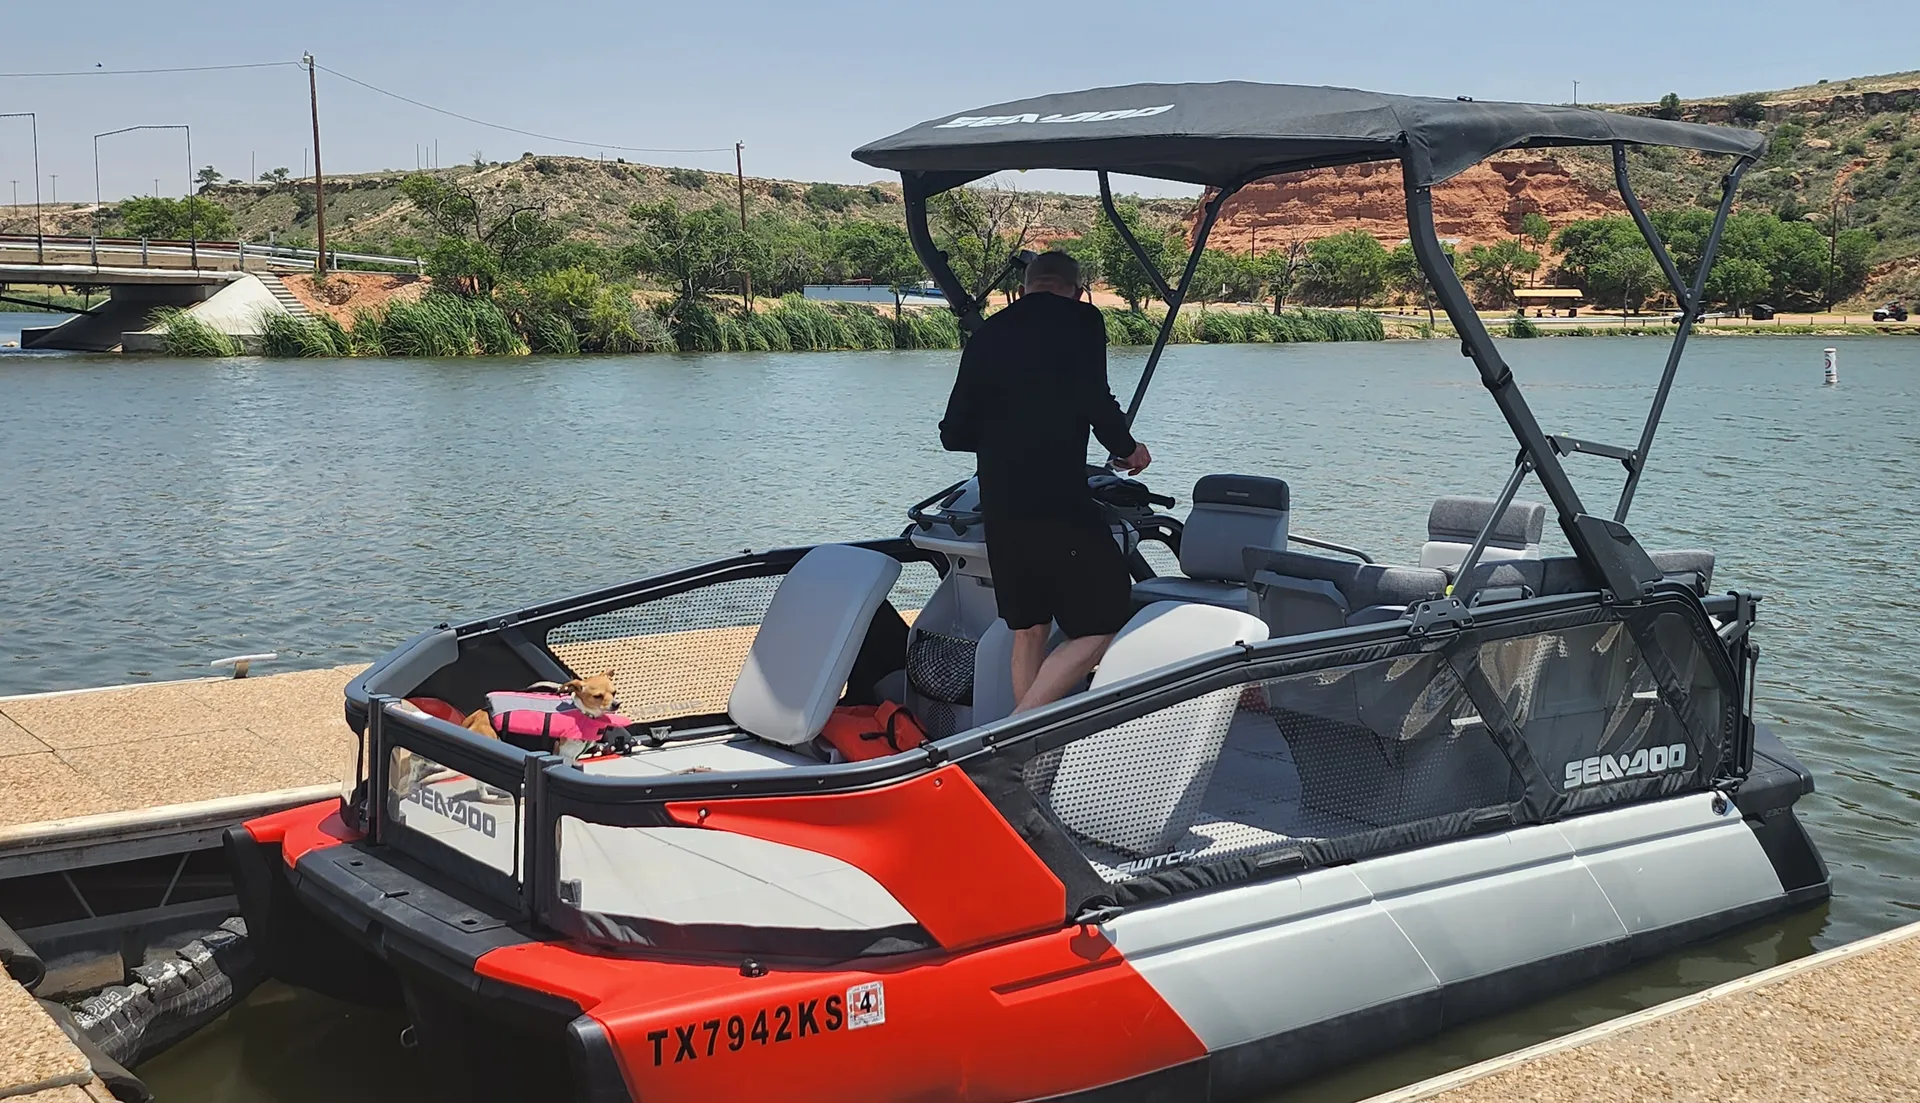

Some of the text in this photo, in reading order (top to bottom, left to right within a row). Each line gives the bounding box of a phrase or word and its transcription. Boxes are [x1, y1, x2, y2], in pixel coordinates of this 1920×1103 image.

[1116, 849, 1196, 874] SWITCH
[860, 991, 872, 1013] 4
[647, 994, 843, 1067] TX7942KS
